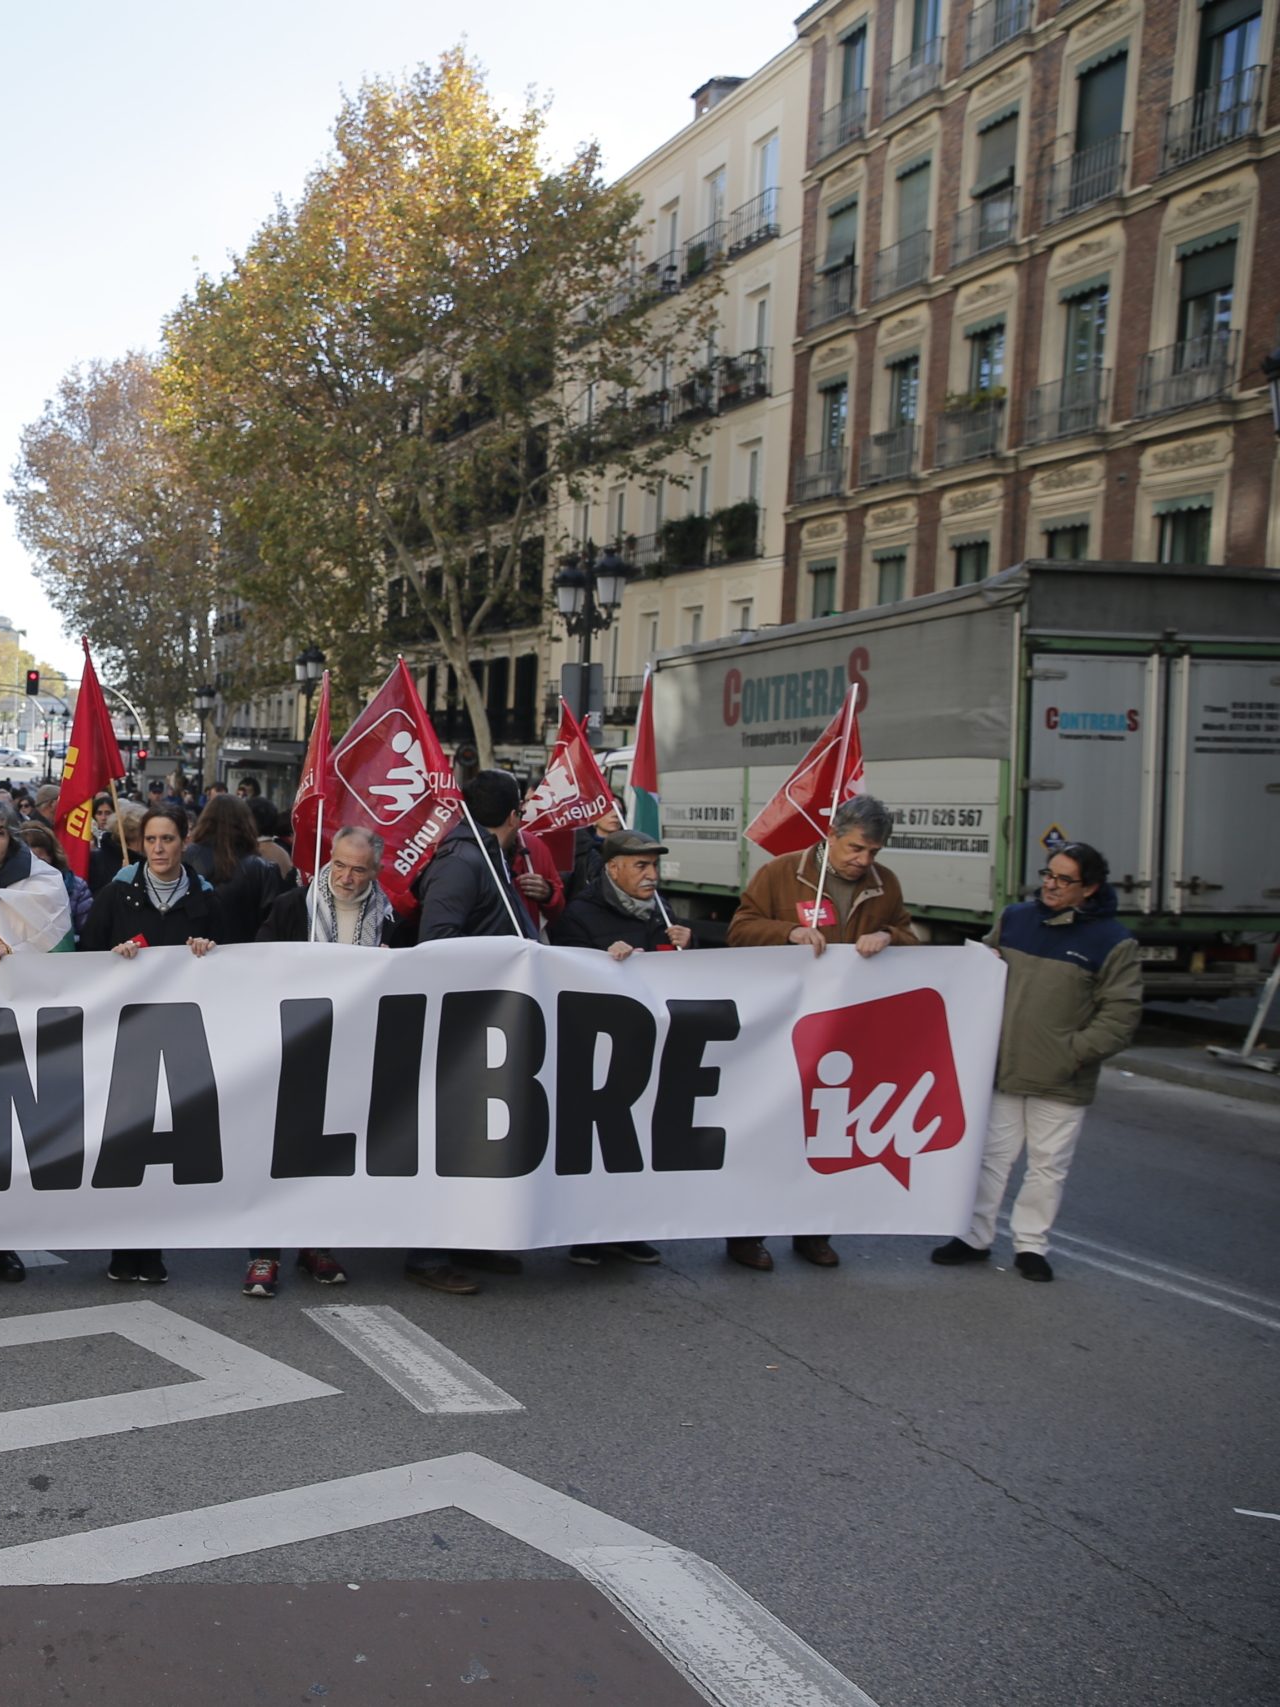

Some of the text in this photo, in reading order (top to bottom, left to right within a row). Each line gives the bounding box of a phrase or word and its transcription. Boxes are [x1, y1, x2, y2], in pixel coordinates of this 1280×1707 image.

[723, 646, 870, 727] CONTRERAS
[1046, 707, 1139, 732] CONTRERAS
[908, 808, 929, 825] 677
[932, 808, 955, 826] 626
[958, 808, 982, 827] 567
[271, 989, 741, 1179] LIBRE
